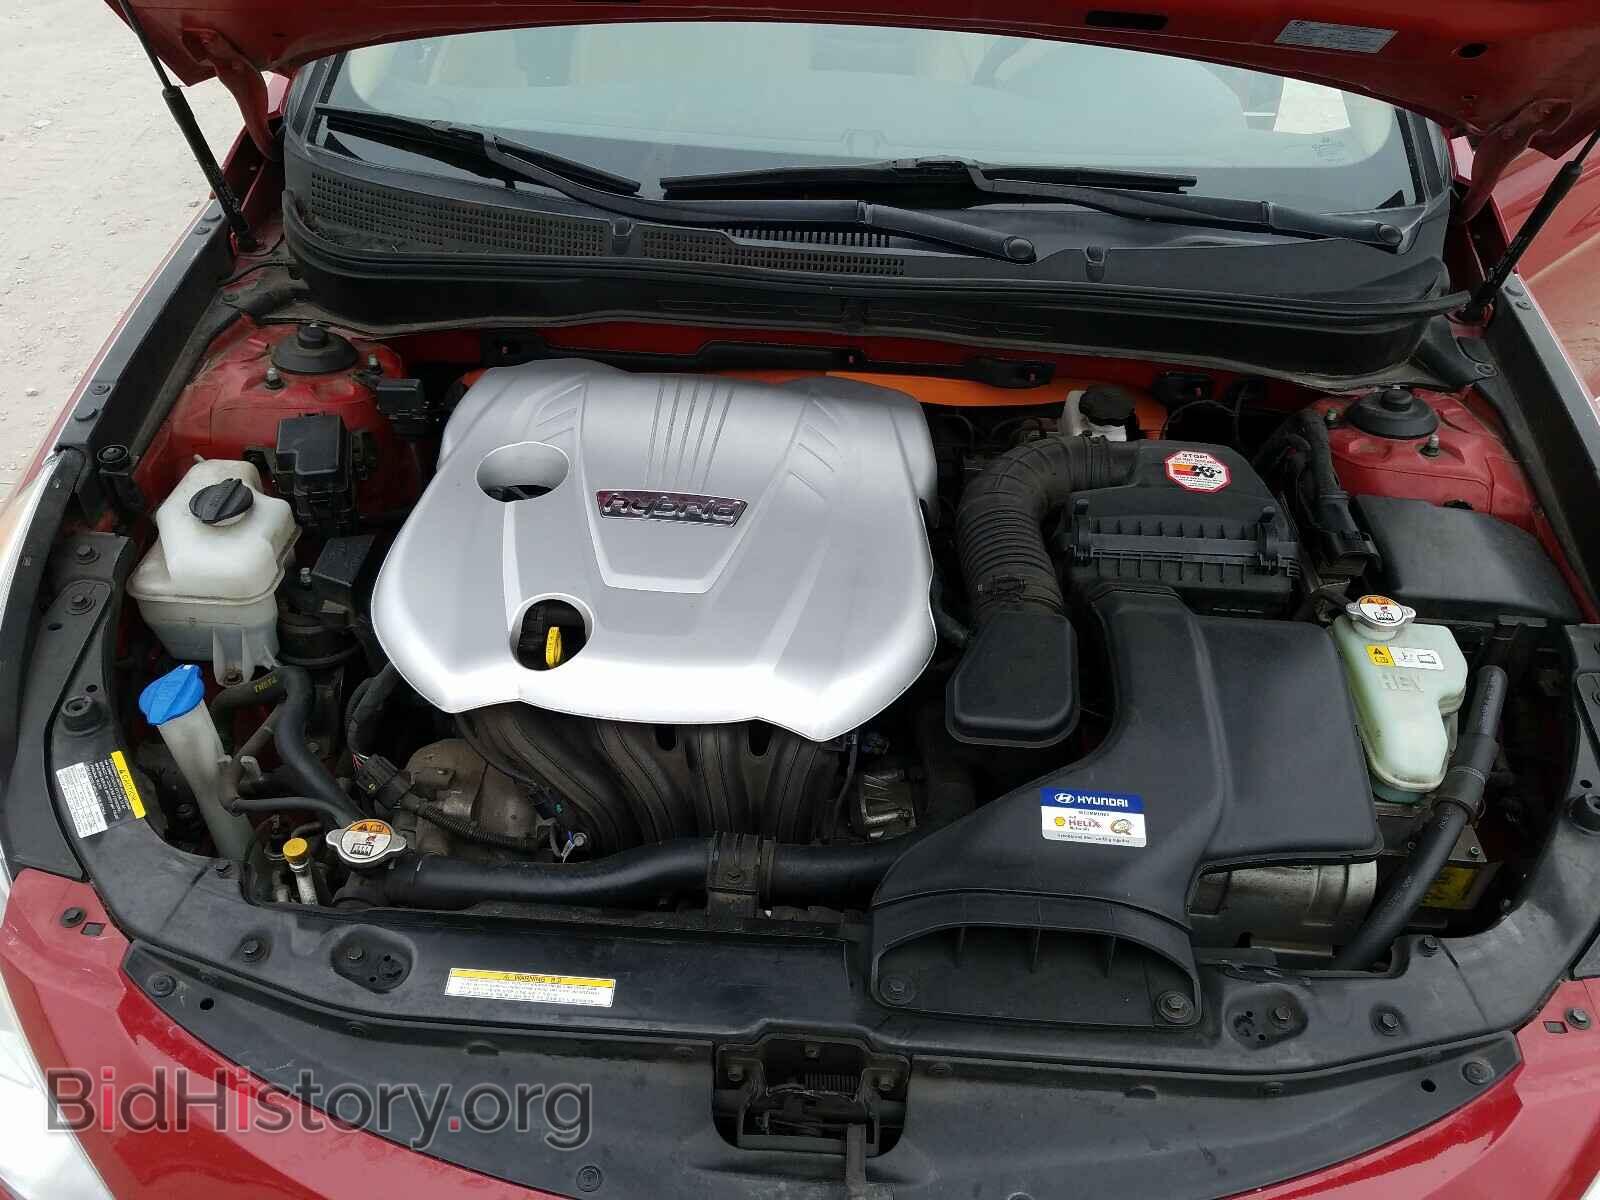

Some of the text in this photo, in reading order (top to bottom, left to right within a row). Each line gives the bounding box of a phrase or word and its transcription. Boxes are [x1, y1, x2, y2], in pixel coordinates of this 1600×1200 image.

[604, 493, 742, 519] hybrid
[1077, 795, 1129, 808] HYUNDAI
[1068, 818, 1102, 828] HELIX
[514, 975, 546, 984] WARNING
